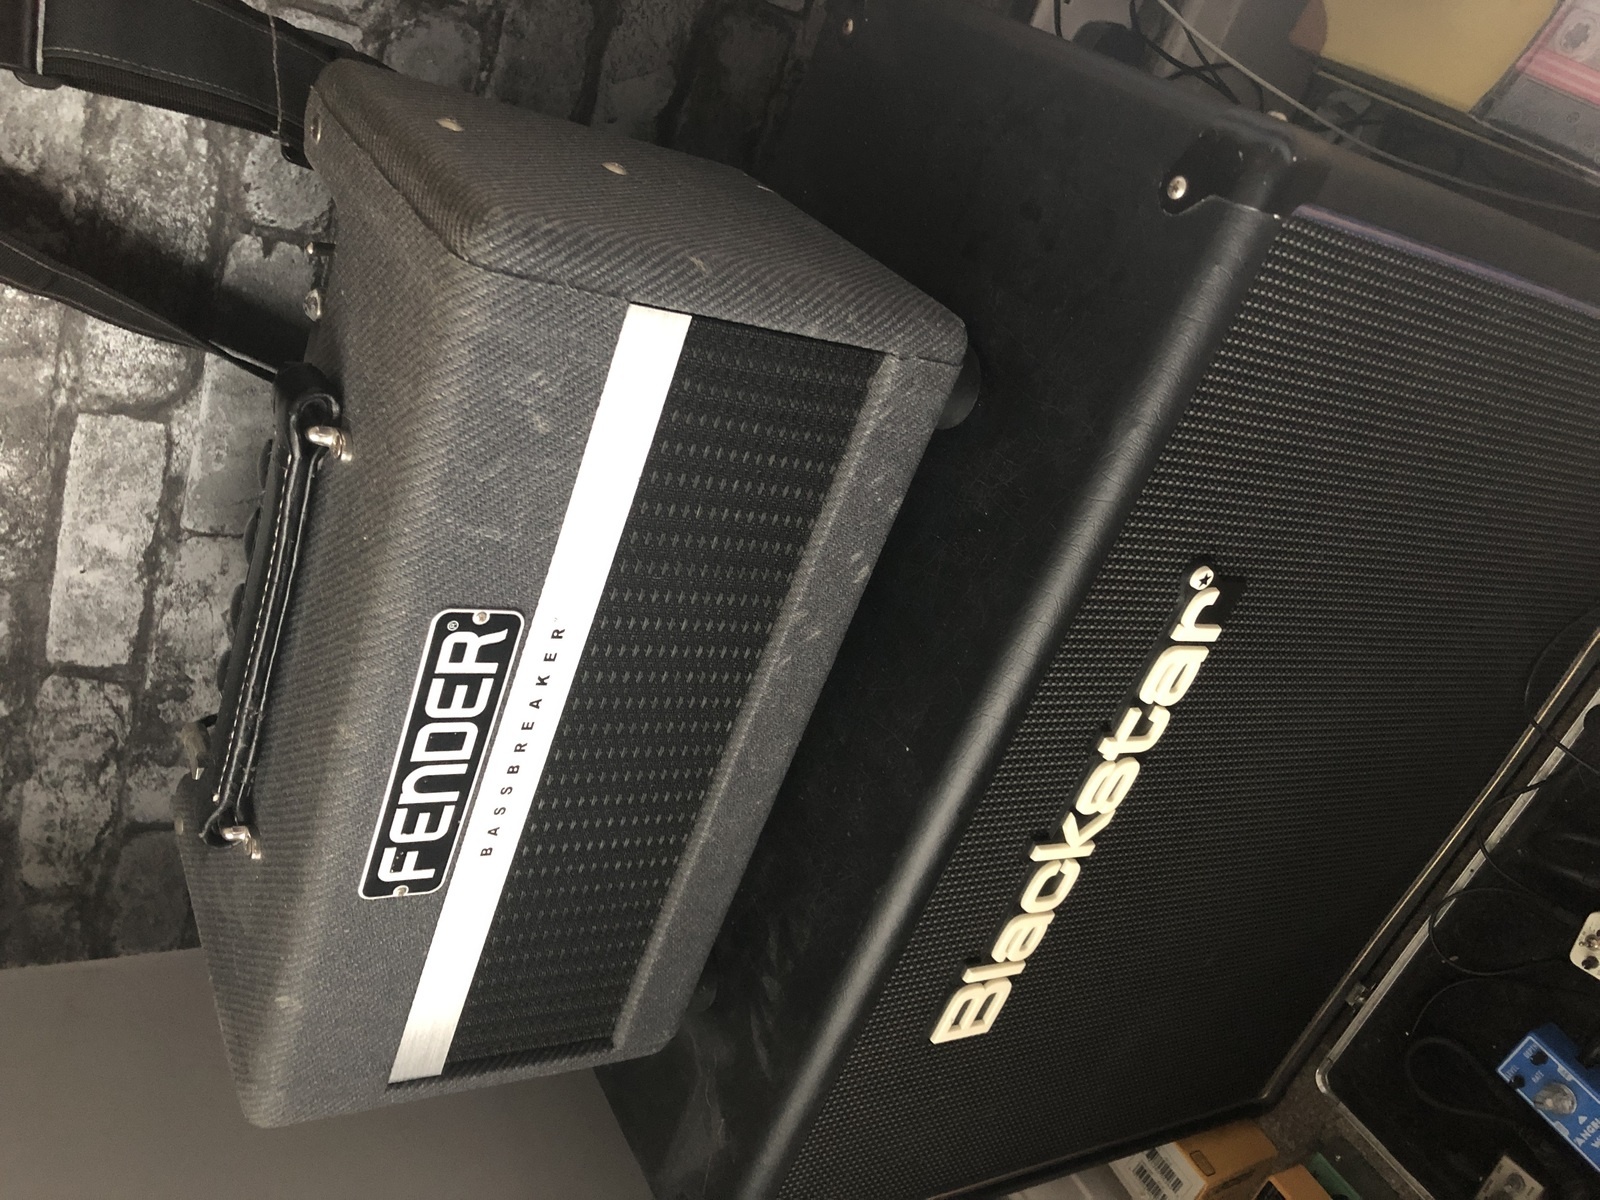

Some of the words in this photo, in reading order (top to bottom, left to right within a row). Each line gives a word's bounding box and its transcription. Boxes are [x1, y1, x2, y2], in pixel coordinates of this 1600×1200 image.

[480, 628, 566, 857] BASSBREAKER
[930, 586, 1222, 1044] Blackstar
[1531, 1070, 1545, 1083] RATE
